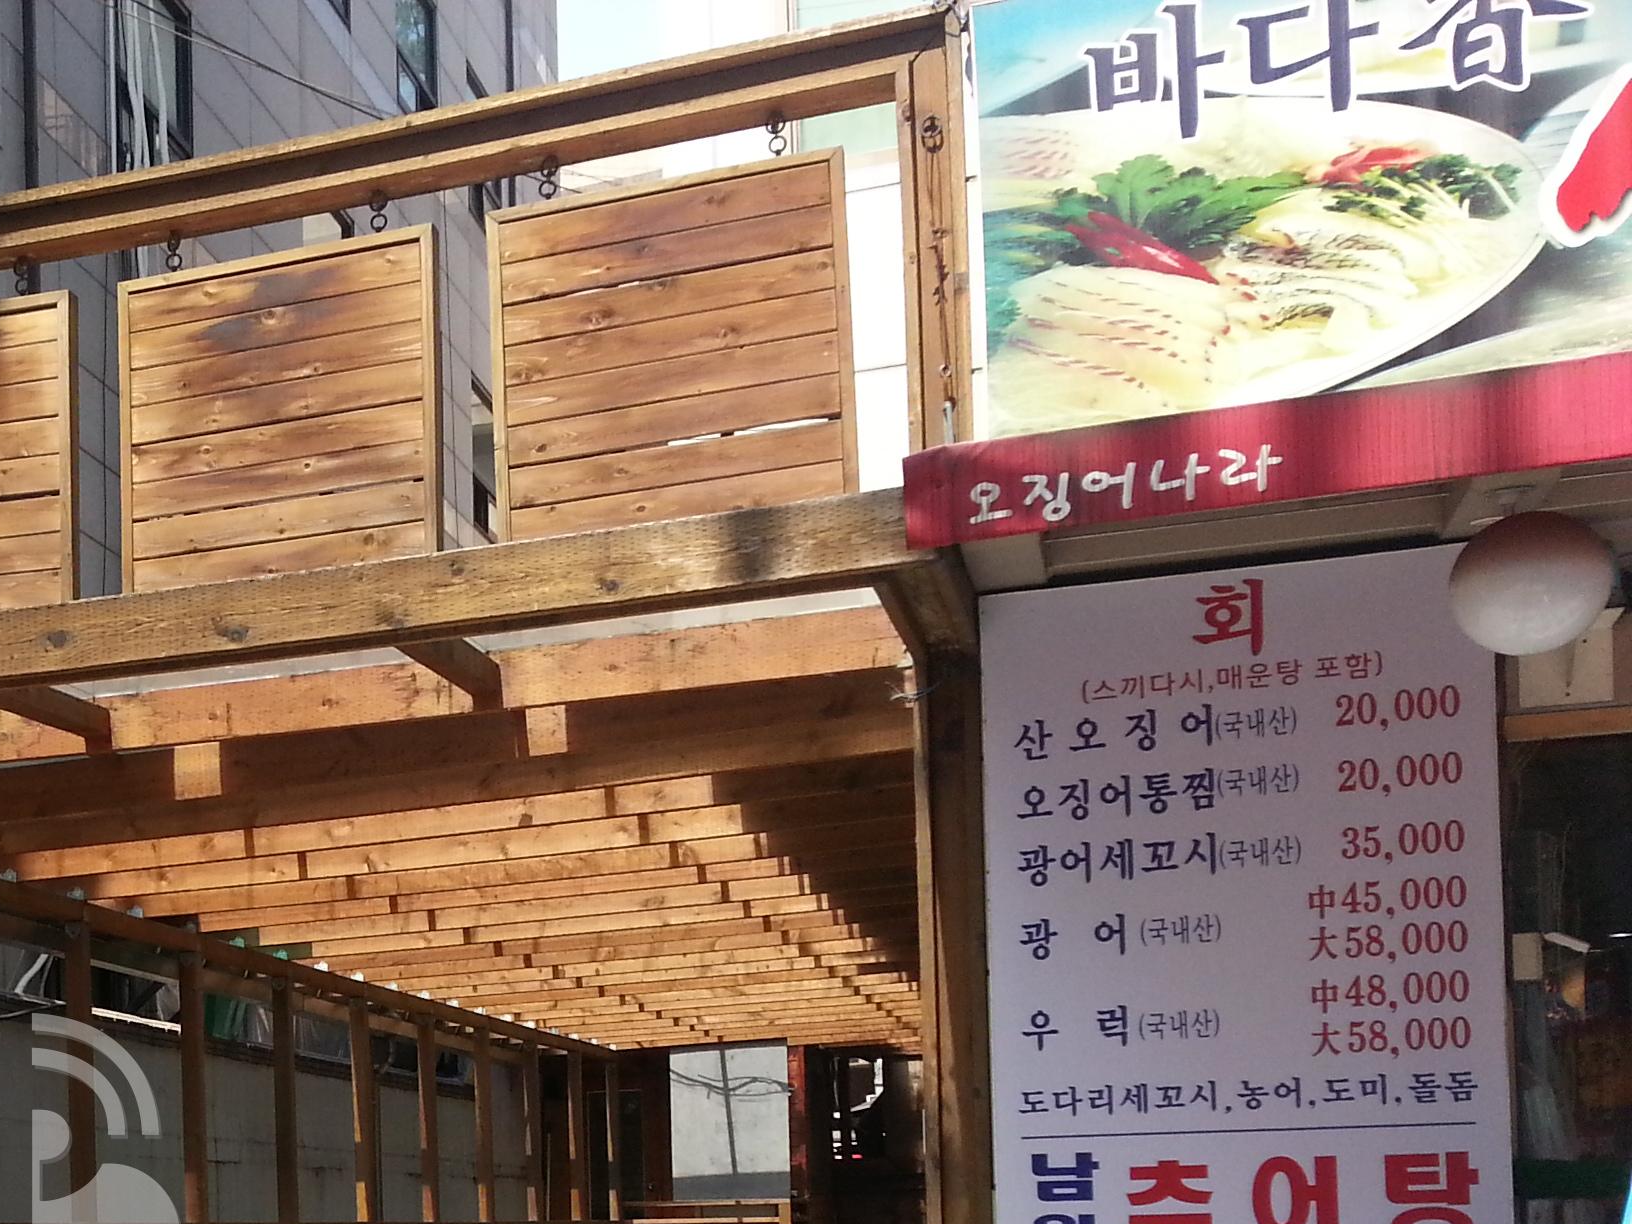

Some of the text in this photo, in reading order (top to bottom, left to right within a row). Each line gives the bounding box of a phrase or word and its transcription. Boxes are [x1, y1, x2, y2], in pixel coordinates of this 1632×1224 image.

[968, 443, 1282, 523] 오징어나라
[1193, 578, 1266, 656] 회
[1314, 650, 1384, 679] 포함)
[1334, 685, 1461, 731] 20,000
[1337, 751, 1464, 797] 20,000
[1341, 819, 1466, 865] 35,000
[1140, 915, 1222, 947] (국내산)
[1138, 1007, 1221, 1040] (국내산)
